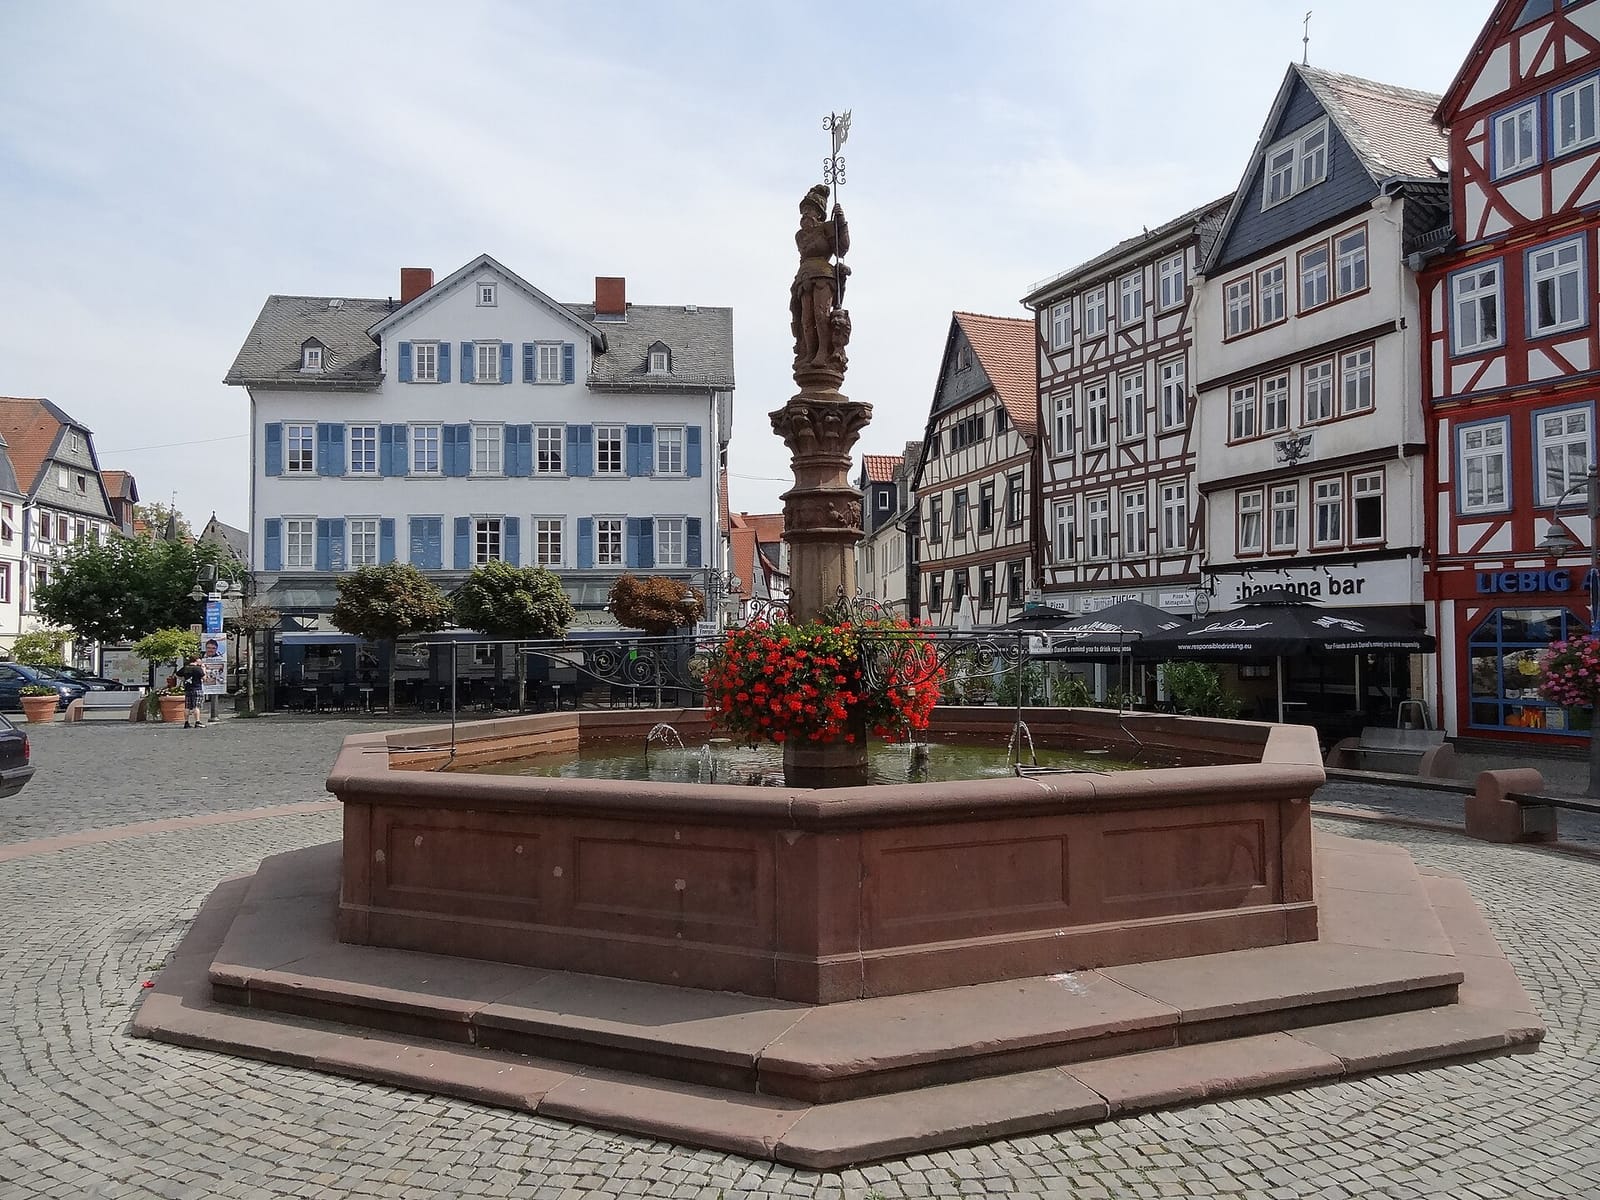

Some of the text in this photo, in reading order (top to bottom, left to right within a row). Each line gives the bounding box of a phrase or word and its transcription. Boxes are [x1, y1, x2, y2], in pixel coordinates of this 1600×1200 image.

[1328, 577, 1365, 596] bar
[1476, 570, 1569, 593] LIEBIG
[1050, 601, 1065, 609] Pizza
[1177, 642, 1252, 651] www.responsibledrinking.eu
